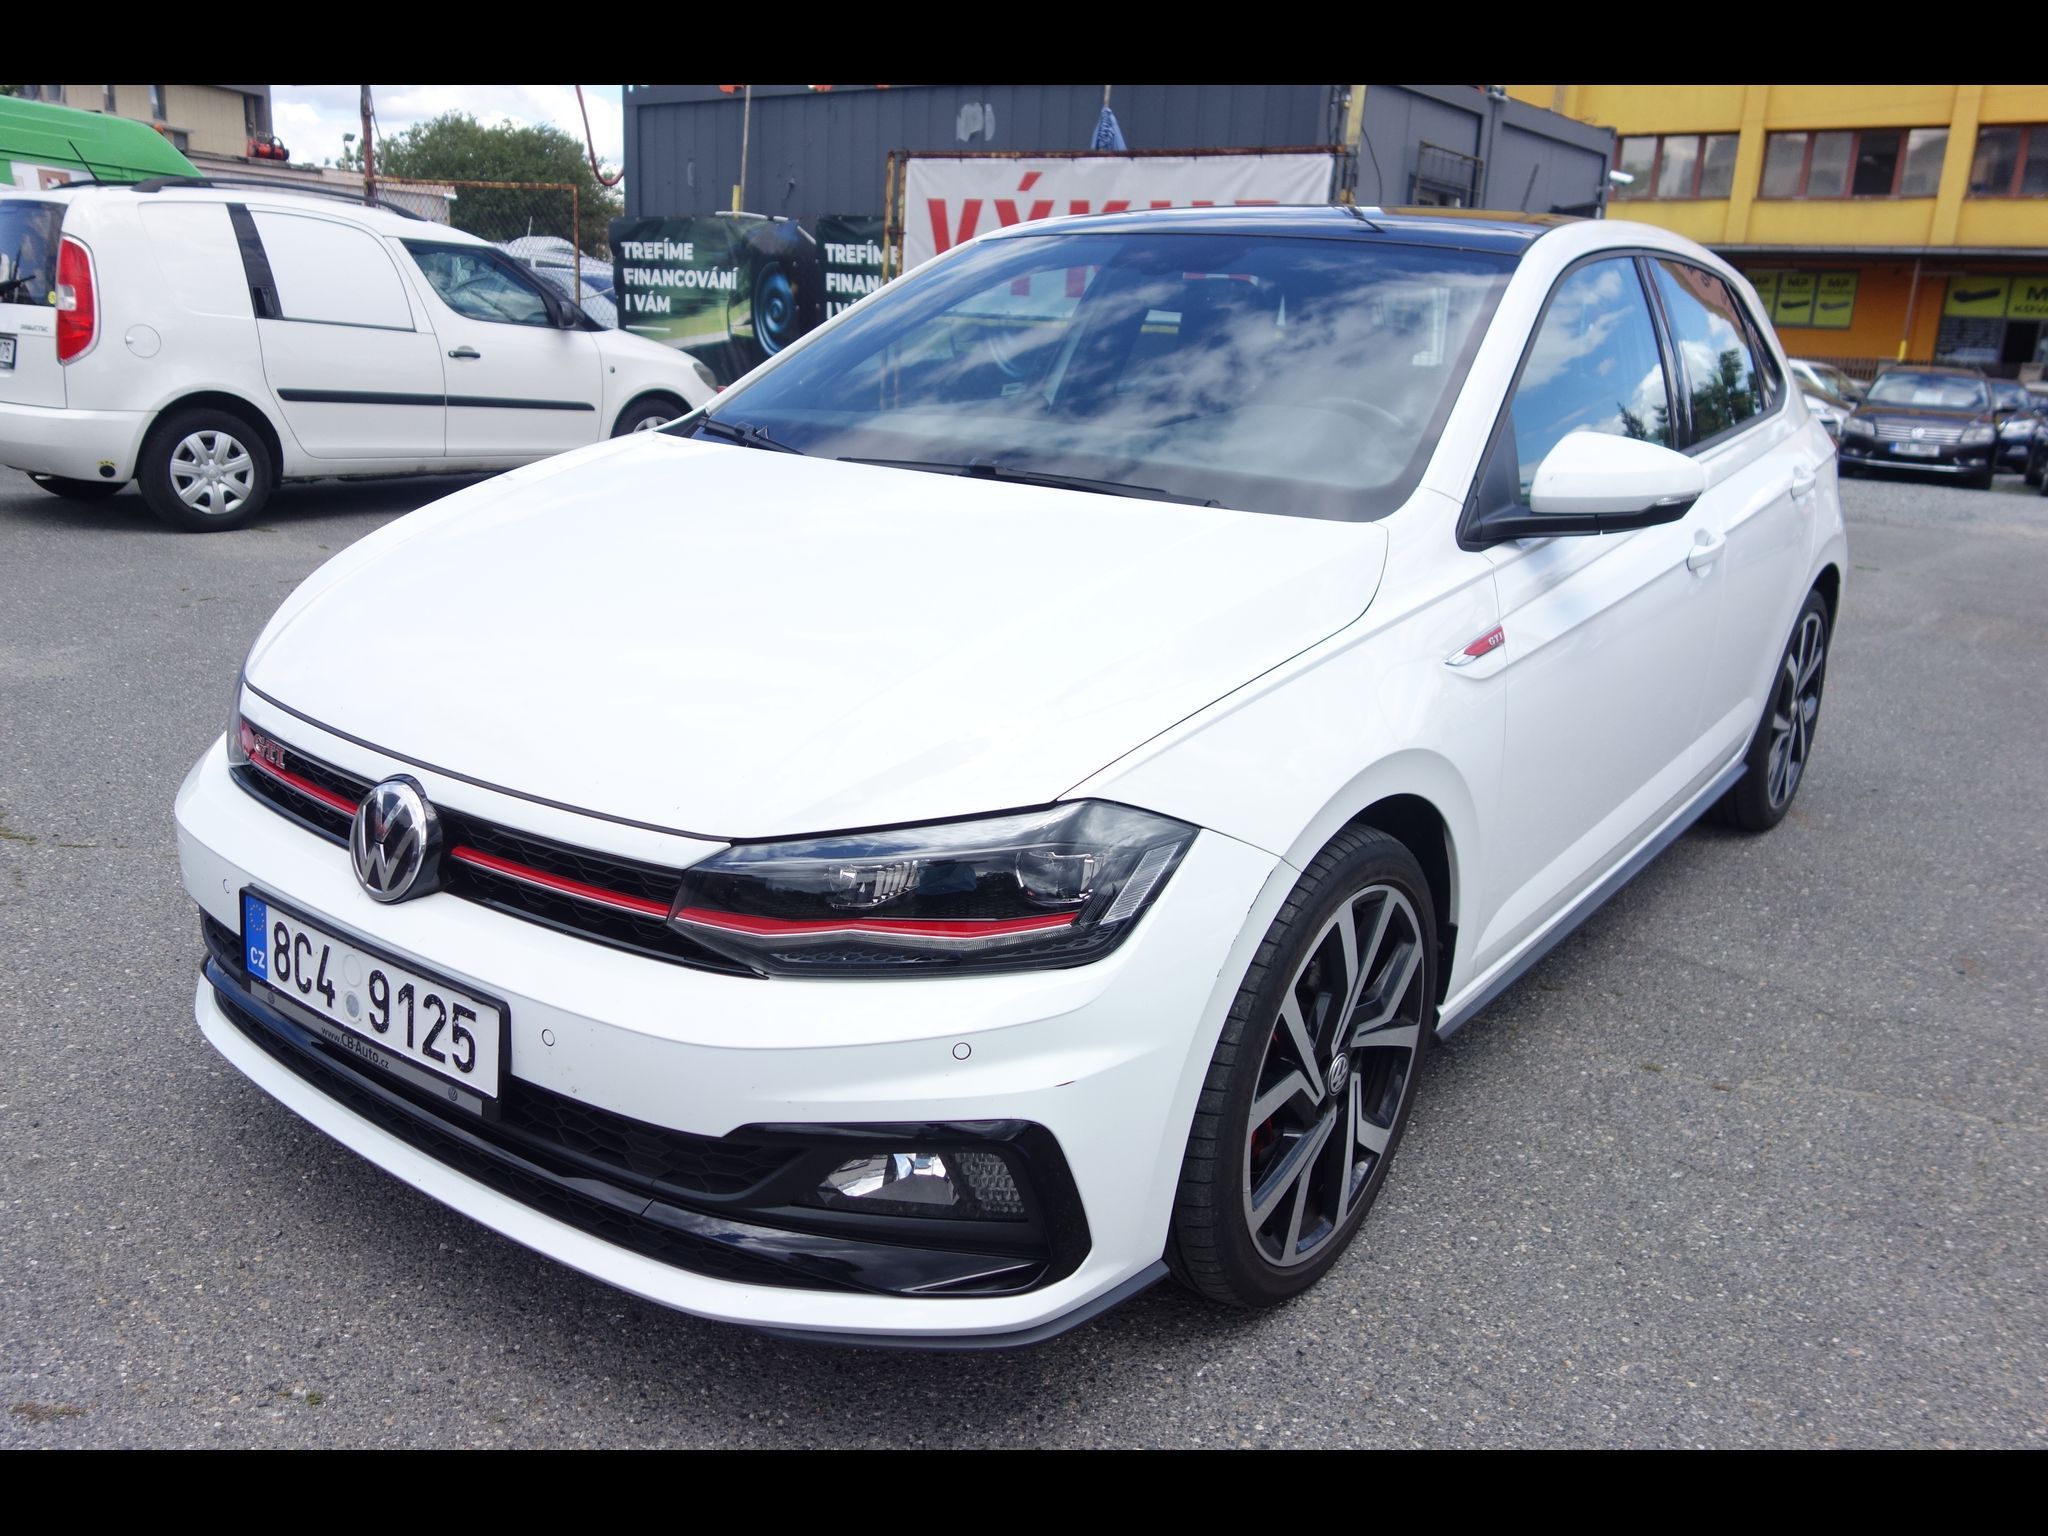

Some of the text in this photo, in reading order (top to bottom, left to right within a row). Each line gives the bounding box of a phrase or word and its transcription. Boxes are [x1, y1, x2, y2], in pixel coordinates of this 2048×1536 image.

[621, 237, 694, 261] TREFÍME
[622, 266, 739, 290] FINANCOVÁNÍ
[625, 290, 671, 313] I VÁM
[253, 733, 286, 769] GTI
[250, 946, 266, 969] CZ
[273, 920, 478, 1075] 8C4 9125
